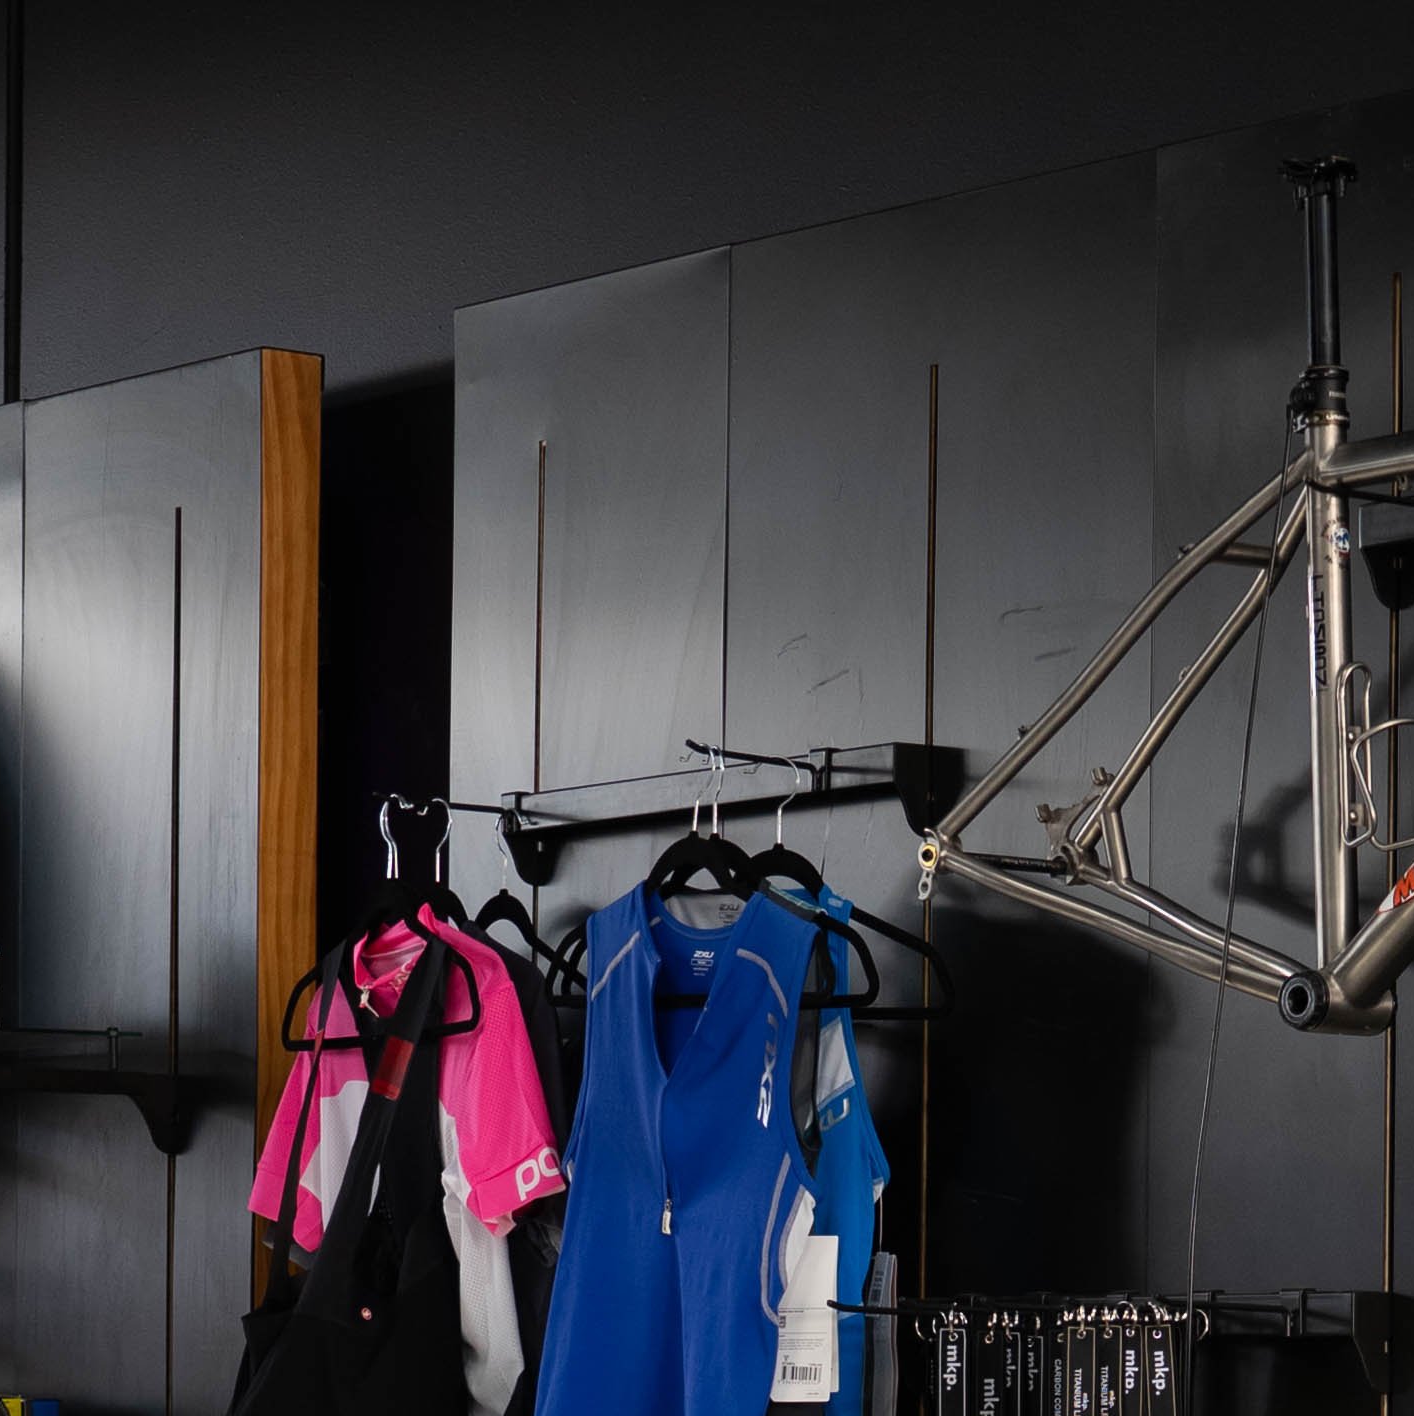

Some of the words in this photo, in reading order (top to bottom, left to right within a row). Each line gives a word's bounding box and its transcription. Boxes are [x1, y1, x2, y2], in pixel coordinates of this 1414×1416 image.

[942, 1344, 962, 1391] mkp.
[1053, 1358, 1063, 1397] CARBON
[1073, 1367, 1083, 1409] TITANIUM
[1100, 1365, 1110, 1406] TITANIUM
[1151, 1350, 1170, 1396] mkp.
